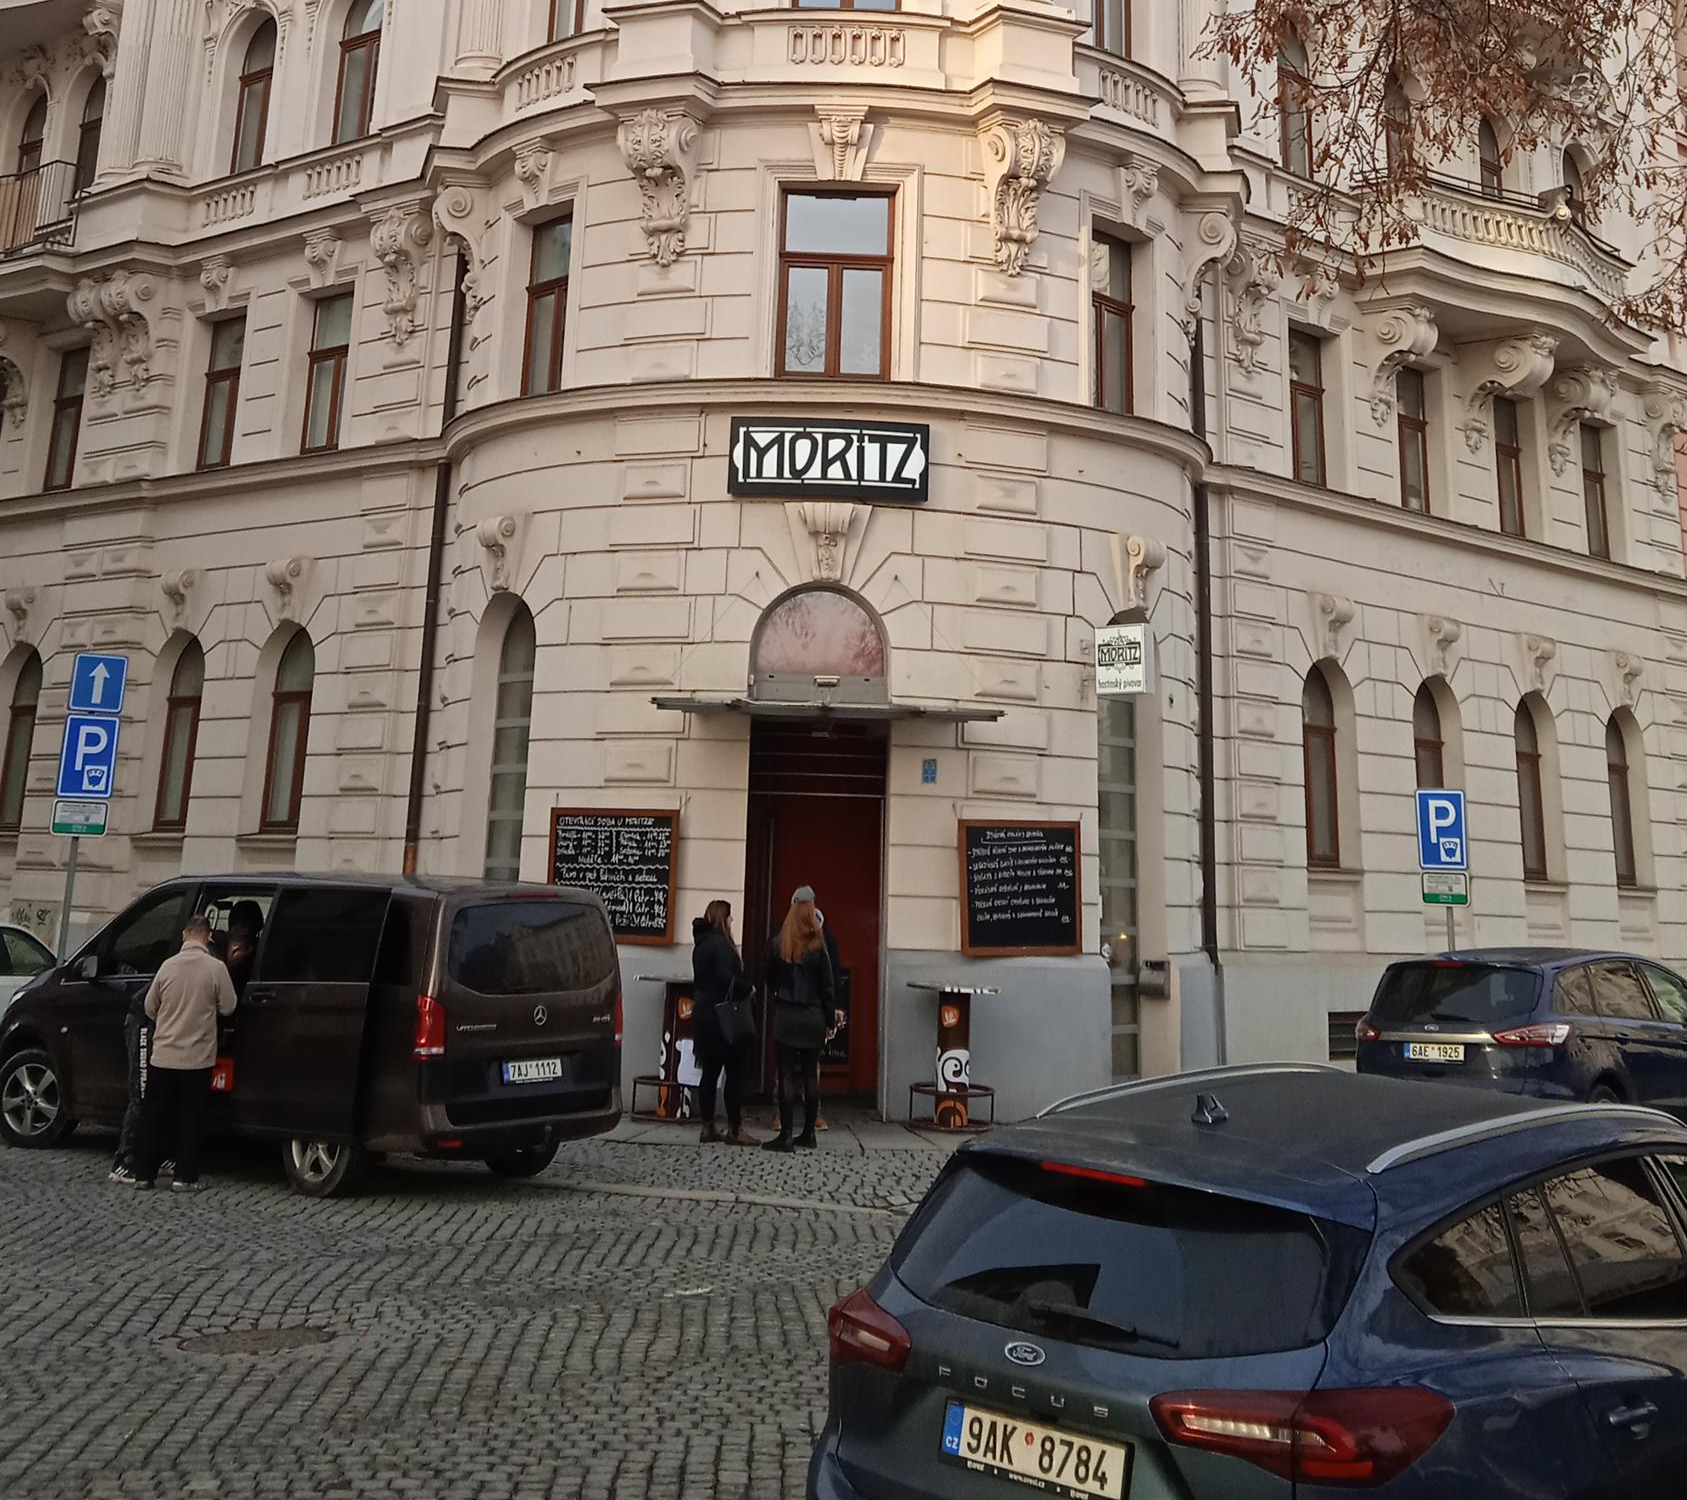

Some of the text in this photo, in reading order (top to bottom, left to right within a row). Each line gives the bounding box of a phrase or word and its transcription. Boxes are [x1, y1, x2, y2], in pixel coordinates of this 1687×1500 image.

[74, 725, 108, 771] P
[1427, 799, 1456, 844] P
[510, 1063, 529, 1079] 7AJ
[535, 1061, 558, 1077] 1112
[1412, 1045, 1460, 1059] 6AE 1925
[938, 1366, 1109, 1418] FOCUS
[945, 1435, 959, 1450] CZ
[966, 1416, 1108, 1491] 9AK 8784
